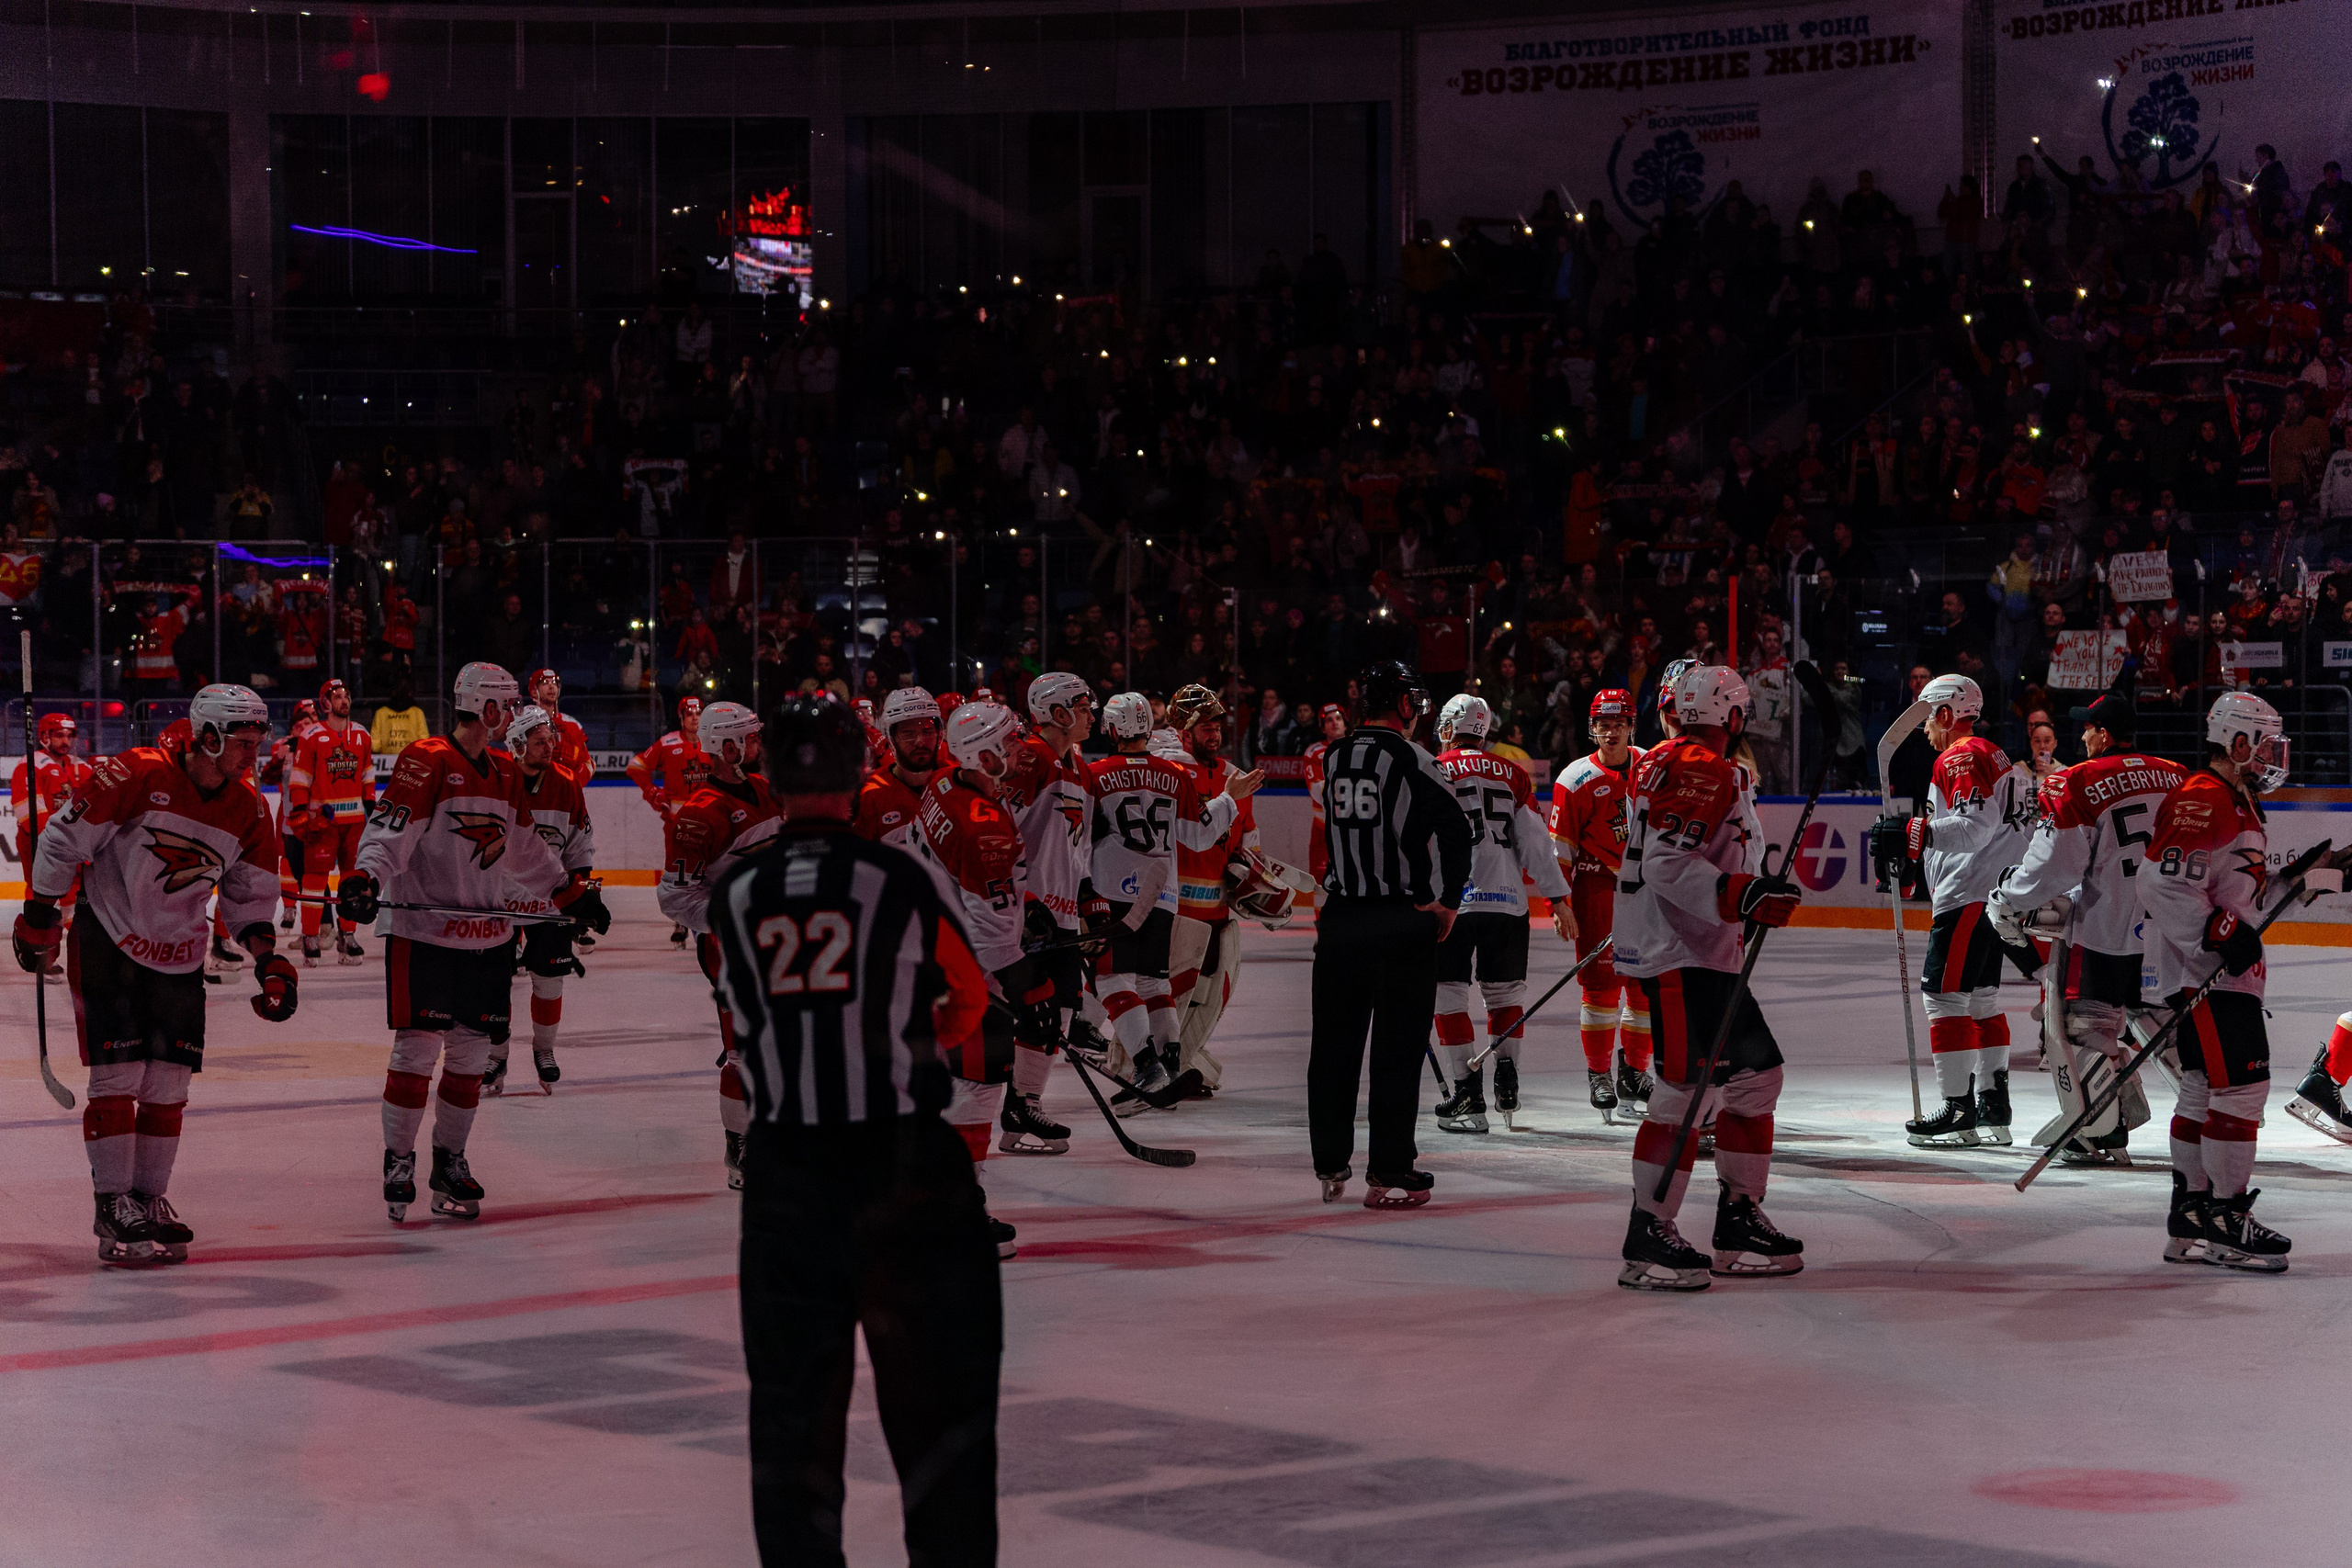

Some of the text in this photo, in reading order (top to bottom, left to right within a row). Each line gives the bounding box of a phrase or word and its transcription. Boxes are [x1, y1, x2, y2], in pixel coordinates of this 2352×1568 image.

[1505, 15, 1871, 61] БЛАГОТВОРИТЕЛЬНЫЙ ФОНД
[1445, 34, 1931, 96] «ВОЗРОЖДЕНИЕ ЖИЗНИ»
[2142, 46, 2254, 73] ВОЗРОЖДЕНИЕ
[2190, 63, 2255, 86] ЖИЗНИ
[1647, 110, 1759, 130] ВОЗРОЖДЕНИЕ
[1697, 125, 1761, 143] ЖИЗНИ
[1098, 768, 1179, 795] CHISTYAKOV
[1445, 758, 1513, 782] AKUPOV
[1333, 777, 1379, 820] 96
[1952, 786, 1986, 814] 44
[2084, 769, 2184, 806] SEREBRYAKO
[368, 798, 413, 833] 20
[1114, 796, 1172, 852] 66
[1657, 812, 1710, 851] 29
[671, 859, 706, 887] 14
[1577, 862, 1600, 873] CM
[2159, 845, 2211, 882] 86
[1180, 885, 1221, 900] SIBUR
[116, 933, 196, 963] FONBET
[754, 908, 854, 997] 22
[1896, 928, 1909, 995] JETSPEED
